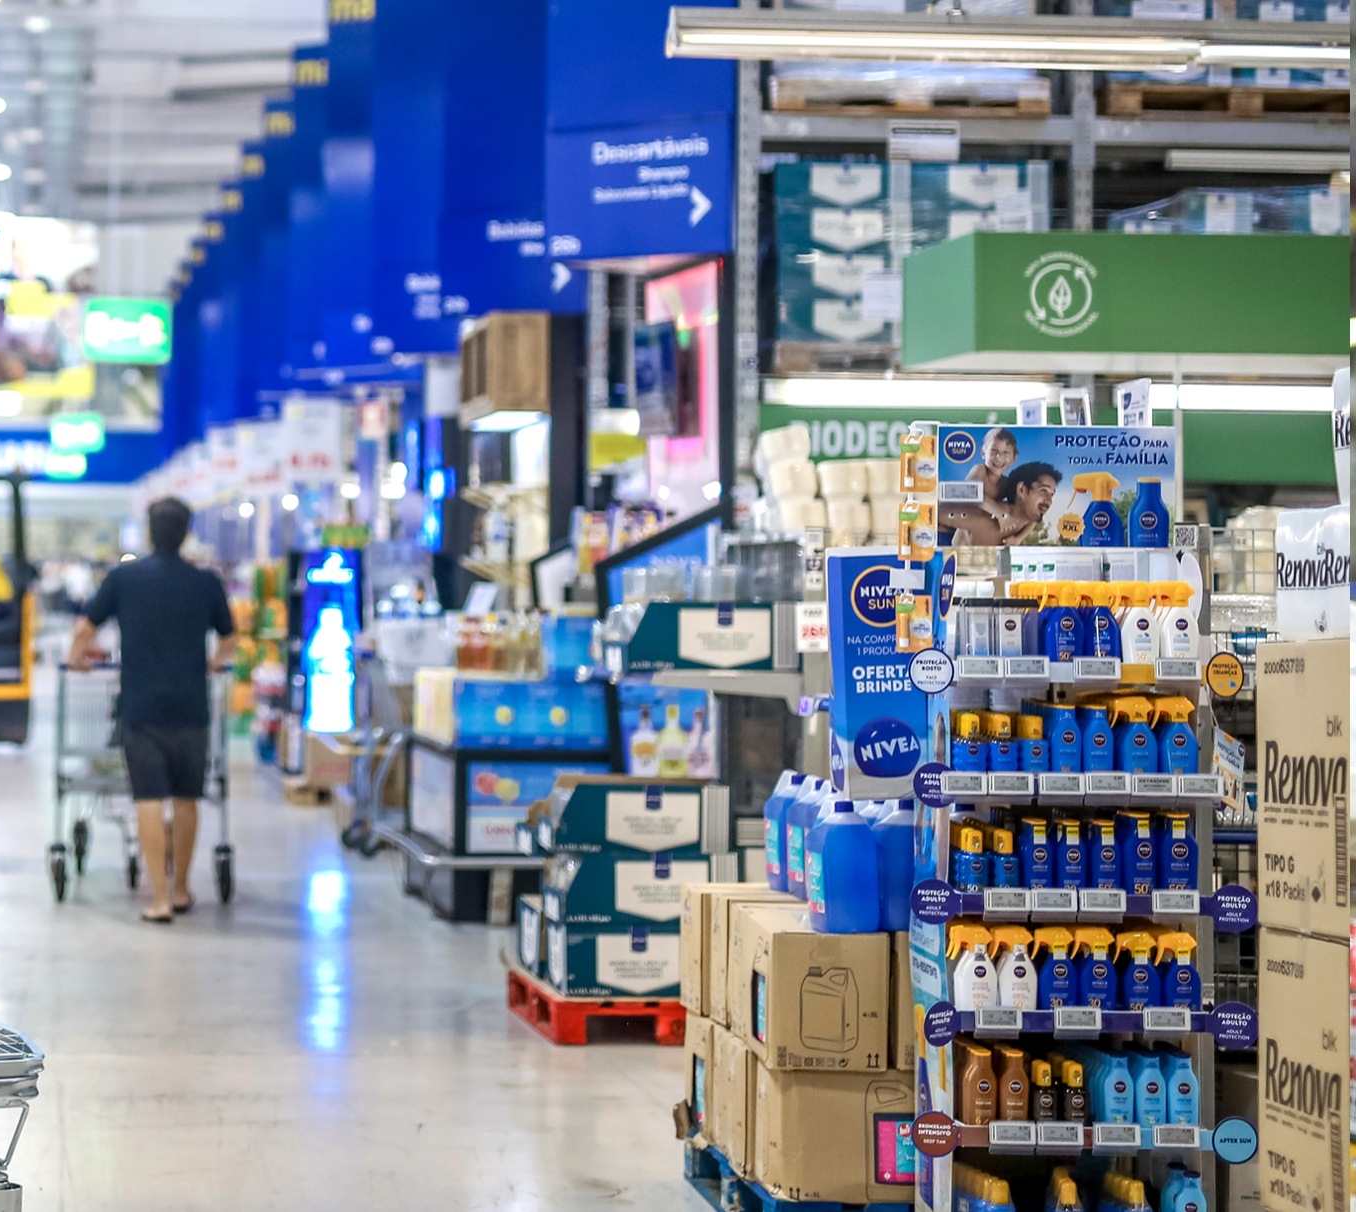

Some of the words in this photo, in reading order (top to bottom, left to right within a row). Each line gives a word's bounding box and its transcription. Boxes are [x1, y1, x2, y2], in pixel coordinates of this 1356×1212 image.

[592, 133, 709, 165] Descartáveis
[948, 441, 971, 449] NIVEA
[1055, 432, 1141, 450] PROTEÇÃO
[1144, 440, 1168, 448] PARA
[1068, 456, 1094, 465] TODA
[1096, 457, 1103, 465] A
[1106, 449, 1168, 465] FAMÍLIA
[1062, 524, 1079, 532] XXL
[847, 636, 861, 645] NA
[864, 635, 896, 645] COMPR
[863, 646, 896, 656] PRODU
[916, 659, 947, 667] PROTEÇÃO
[1264, 657, 1305, 675] 200063789
[856, 680, 912, 694] BRINDE
[1327, 715, 1343, 737] blk
[860, 735, 919, 762] NIVEA
[1264, 741, 1347, 807] Renova
[1265, 853, 1285, 873] TIPO
[1286, 856, 1294, 874] G
[917, 889, 950, 897] PROTEÇÃO
[1265, 879, 1281, 898] x18
[1283, 882, 1305, 902] Packs
[1217, 895, 1251, 904] PROTEÇÃO
[929, 1010, 954, 1019] PROTEÇÃO
[1217, 1012, 1252, 1021] PROTEÇÃO
[1221, 1019, 1248, 1027] ADULTO
[1322, 1028, 1337, 1052] blk
[1266, 1037, 1342, 1120] Renova
[918, 1129, 952, 1137] INTENSIVO
[1268, 1150, 1288, 1174] TIPO
